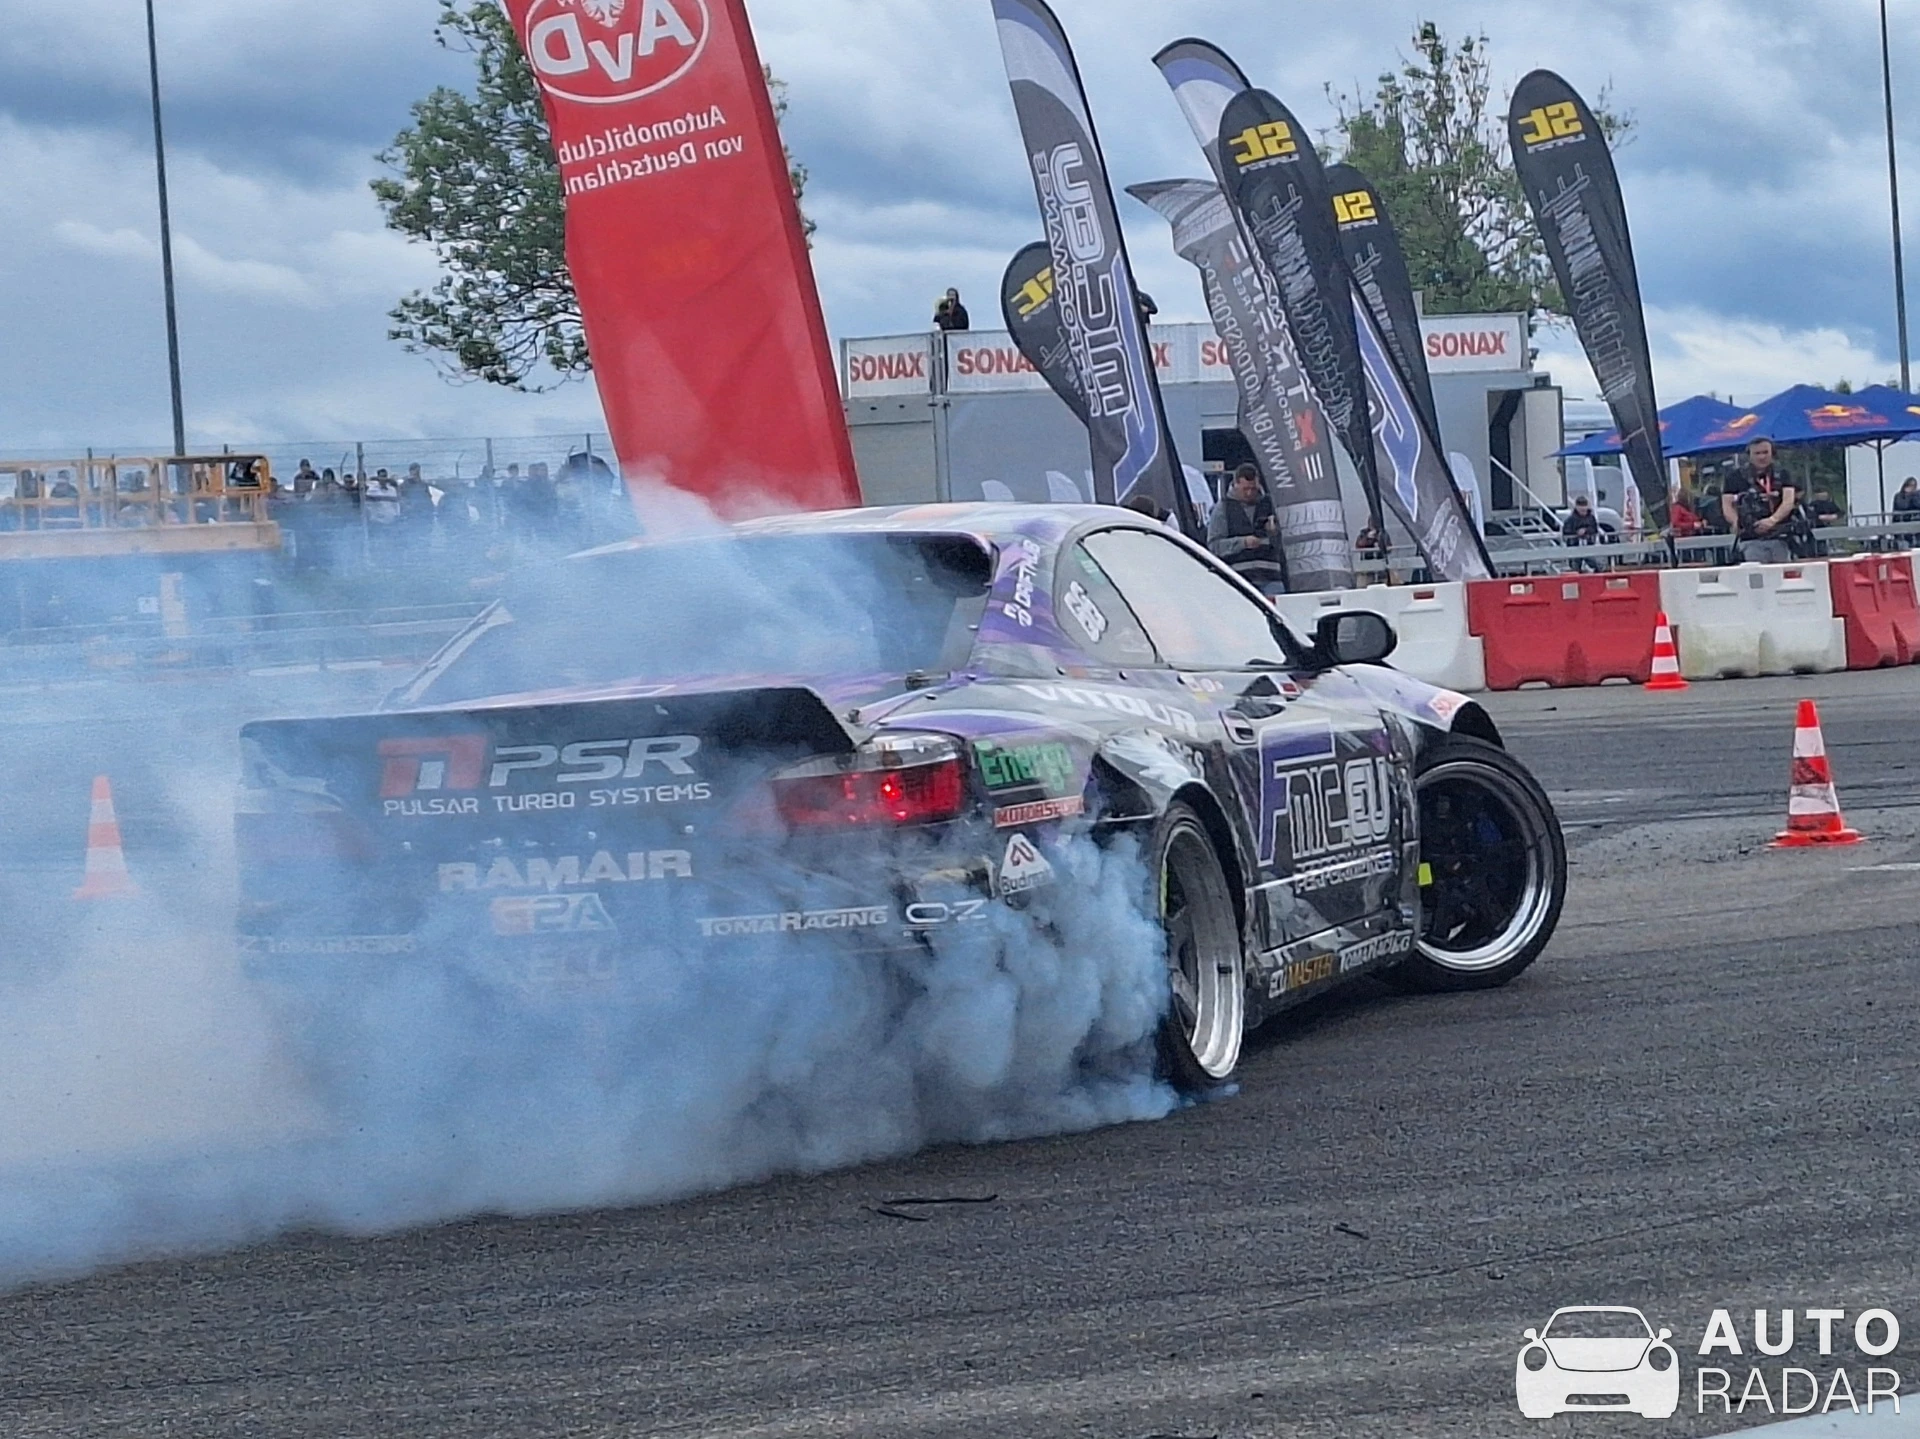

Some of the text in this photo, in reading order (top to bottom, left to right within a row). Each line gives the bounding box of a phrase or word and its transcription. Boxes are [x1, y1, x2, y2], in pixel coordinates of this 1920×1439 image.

[1426, 331, 1507, 358] SONAX
[850, 351, 925, 381] SONAX
[957, 346, 1040, 375] SONA
[488, 734, 702, 787] PSR
[383, 782, 712, 817] PULSAR TURBO SYSTEMS
[997, 797, 1084, 826] MOTORSP
[437, 849, 693, 892] RAMAIR
